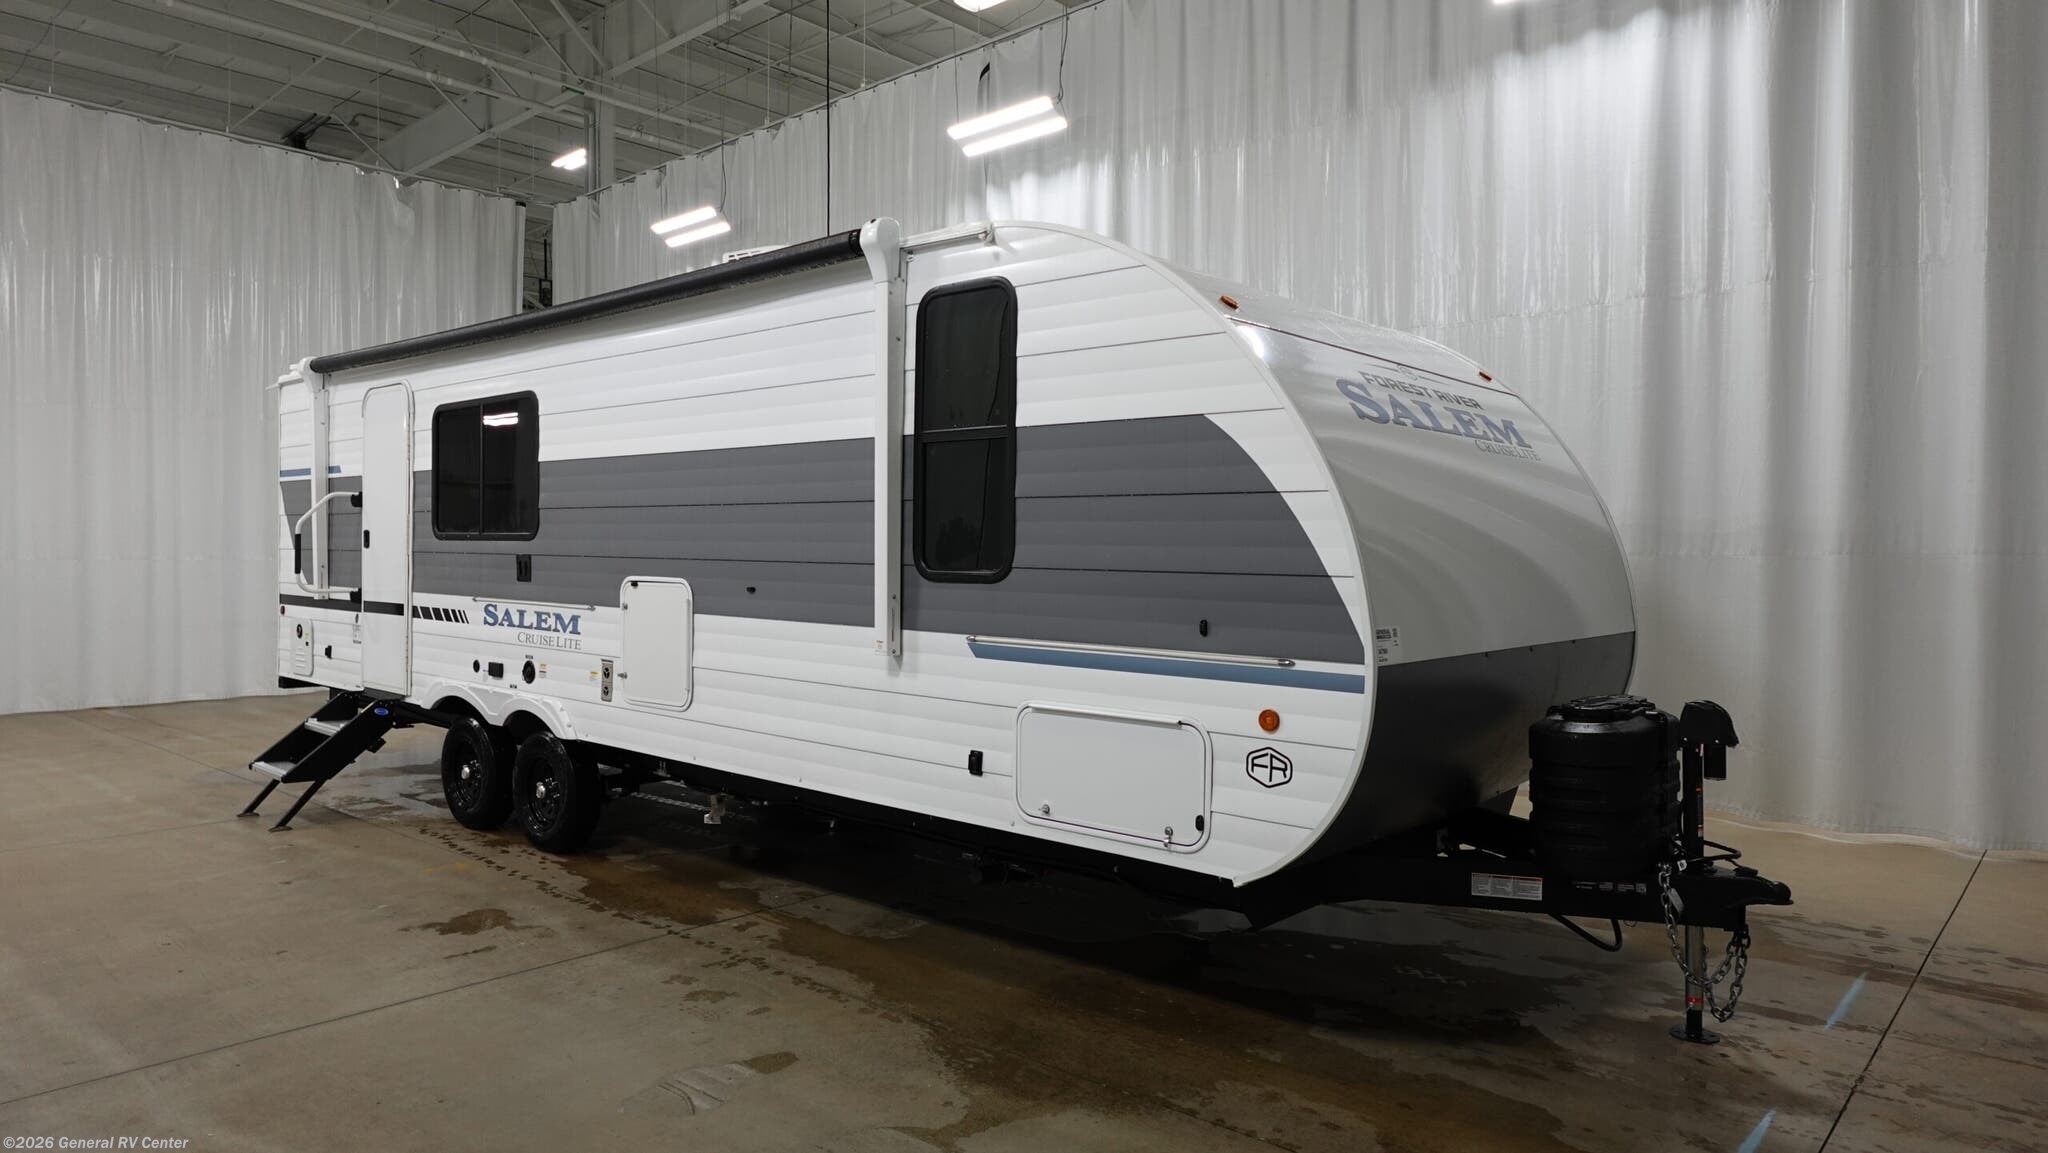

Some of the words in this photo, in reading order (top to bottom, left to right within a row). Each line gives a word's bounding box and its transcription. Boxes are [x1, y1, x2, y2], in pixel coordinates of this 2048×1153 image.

[1359, 371, 1432, 398] FOREST
[1432, 389, 1485, 410] RIVER
[1336, 378, 1533, 449] SALEM
[483, 603, 581, 634] SALEM
